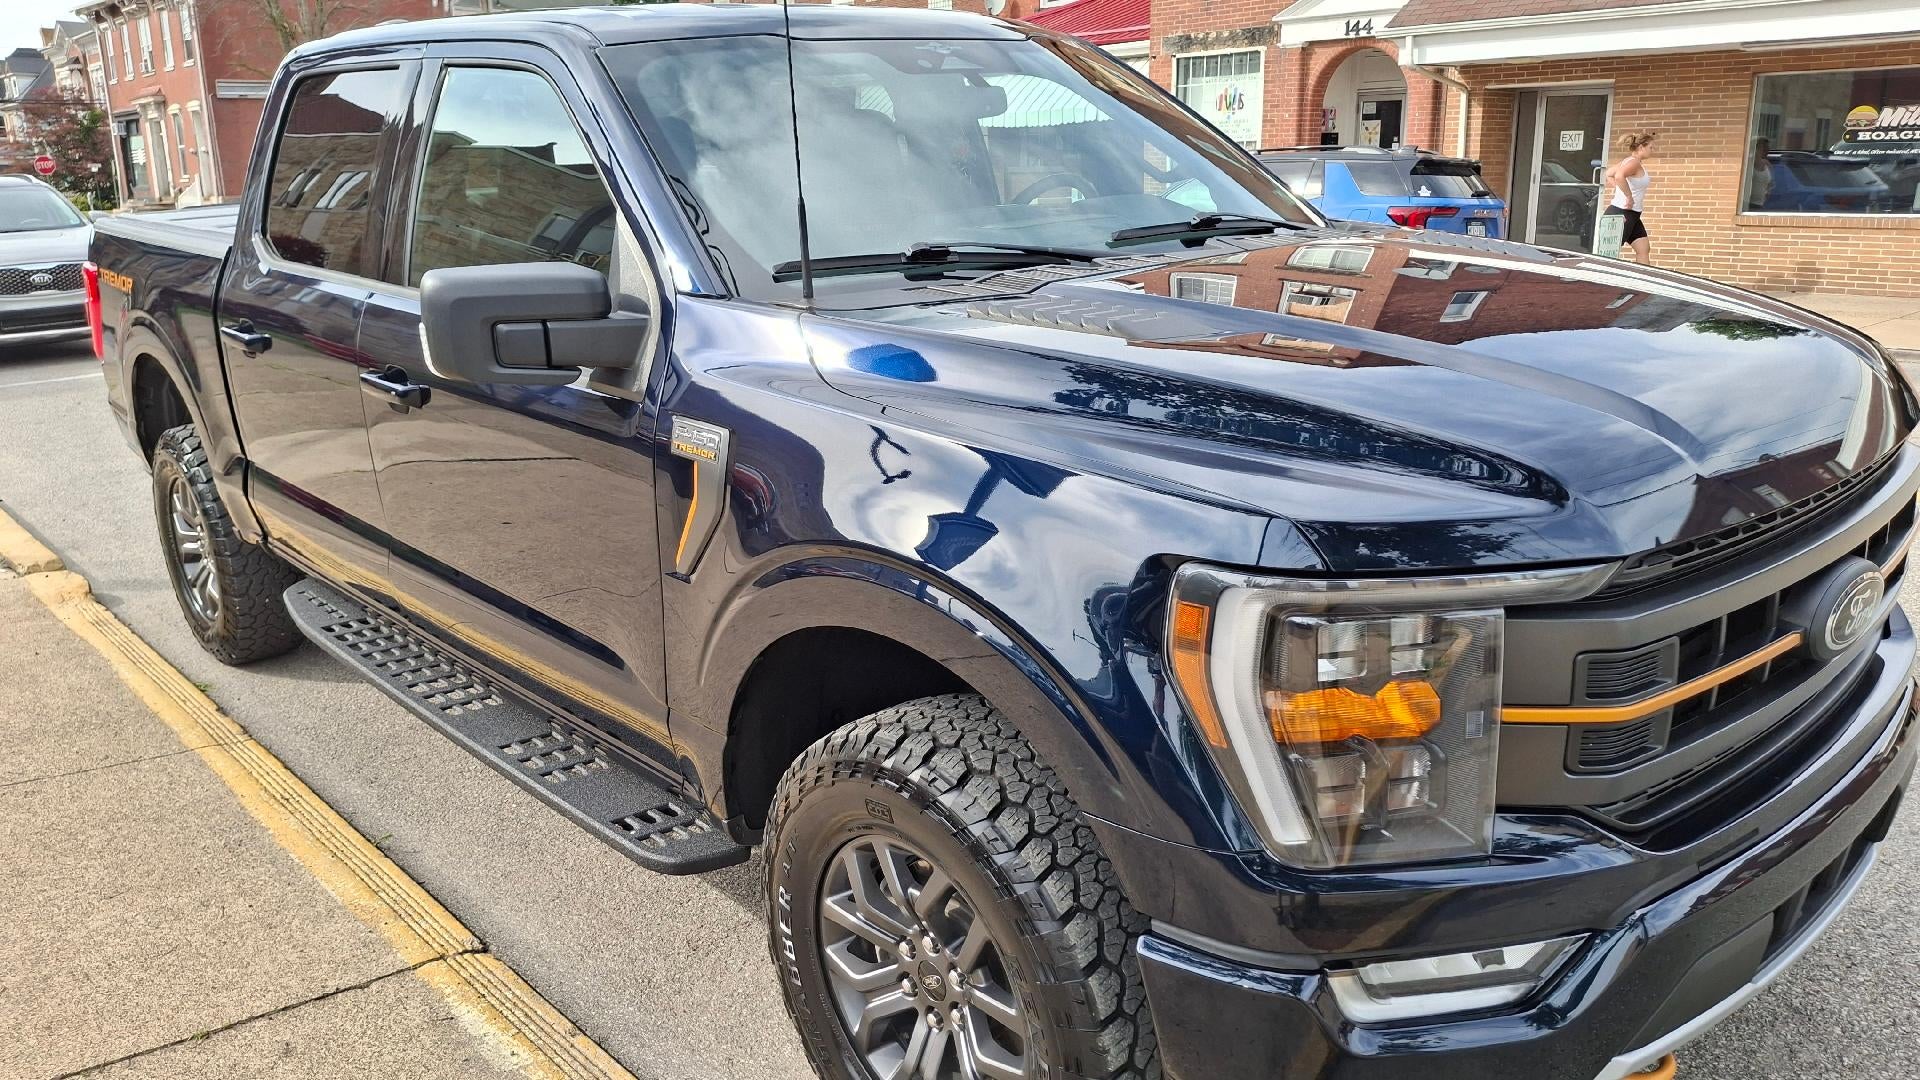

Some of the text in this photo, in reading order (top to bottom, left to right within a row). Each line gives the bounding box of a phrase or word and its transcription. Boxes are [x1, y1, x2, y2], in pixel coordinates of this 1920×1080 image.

[1344, 18, 1373, 36] 144
[1562, 133, 1582, 143] EXIT
[36, 160, 54, 170] STOP
[34, 275, 50, 283] KIA
[99, 267, 133, 295] TREMOR
[673, 440, 716, 460] TREMOR
